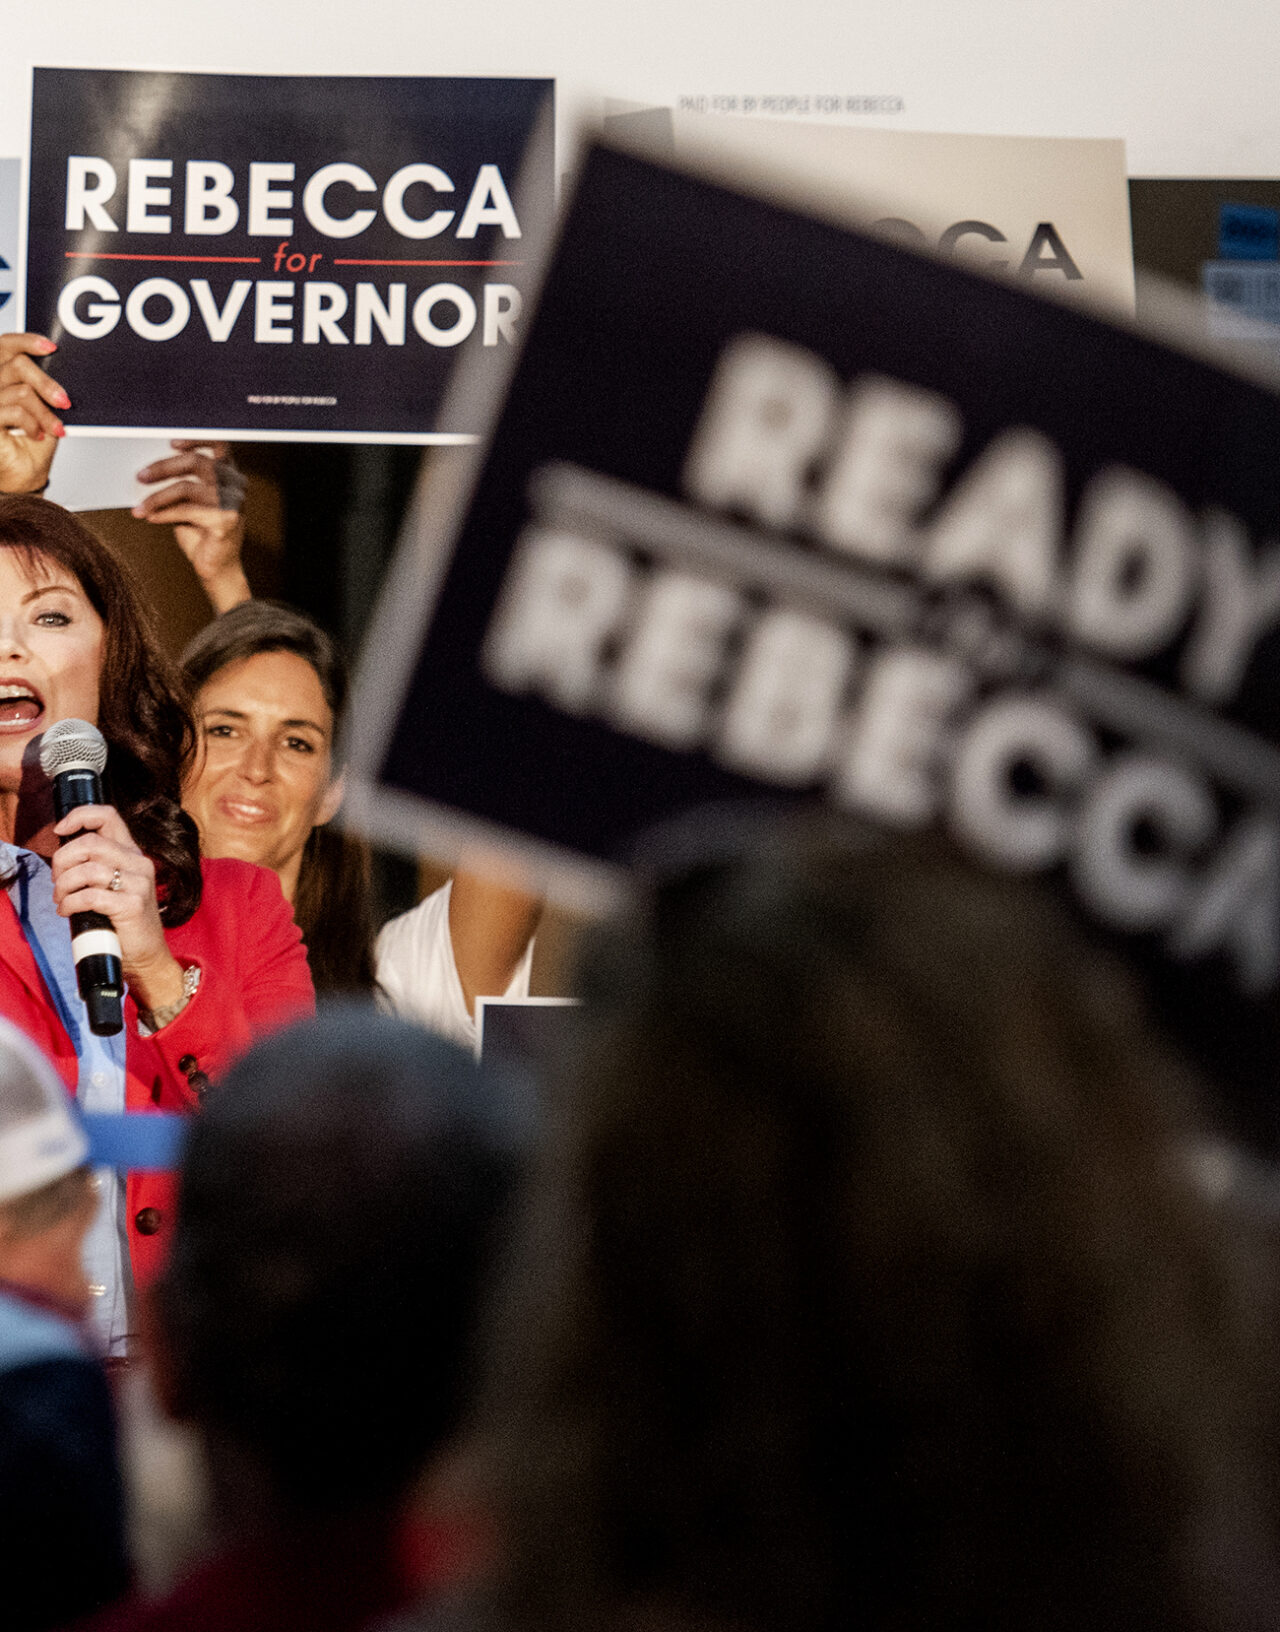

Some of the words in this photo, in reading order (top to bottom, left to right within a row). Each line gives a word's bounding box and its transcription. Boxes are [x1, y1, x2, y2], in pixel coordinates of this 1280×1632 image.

[64, 155, 522, 240] REBECCA
[272, 241, 323, 273] for
[57, 275, 521, 348] GOVERNOR
[684, 333, 1280, 702] READY
